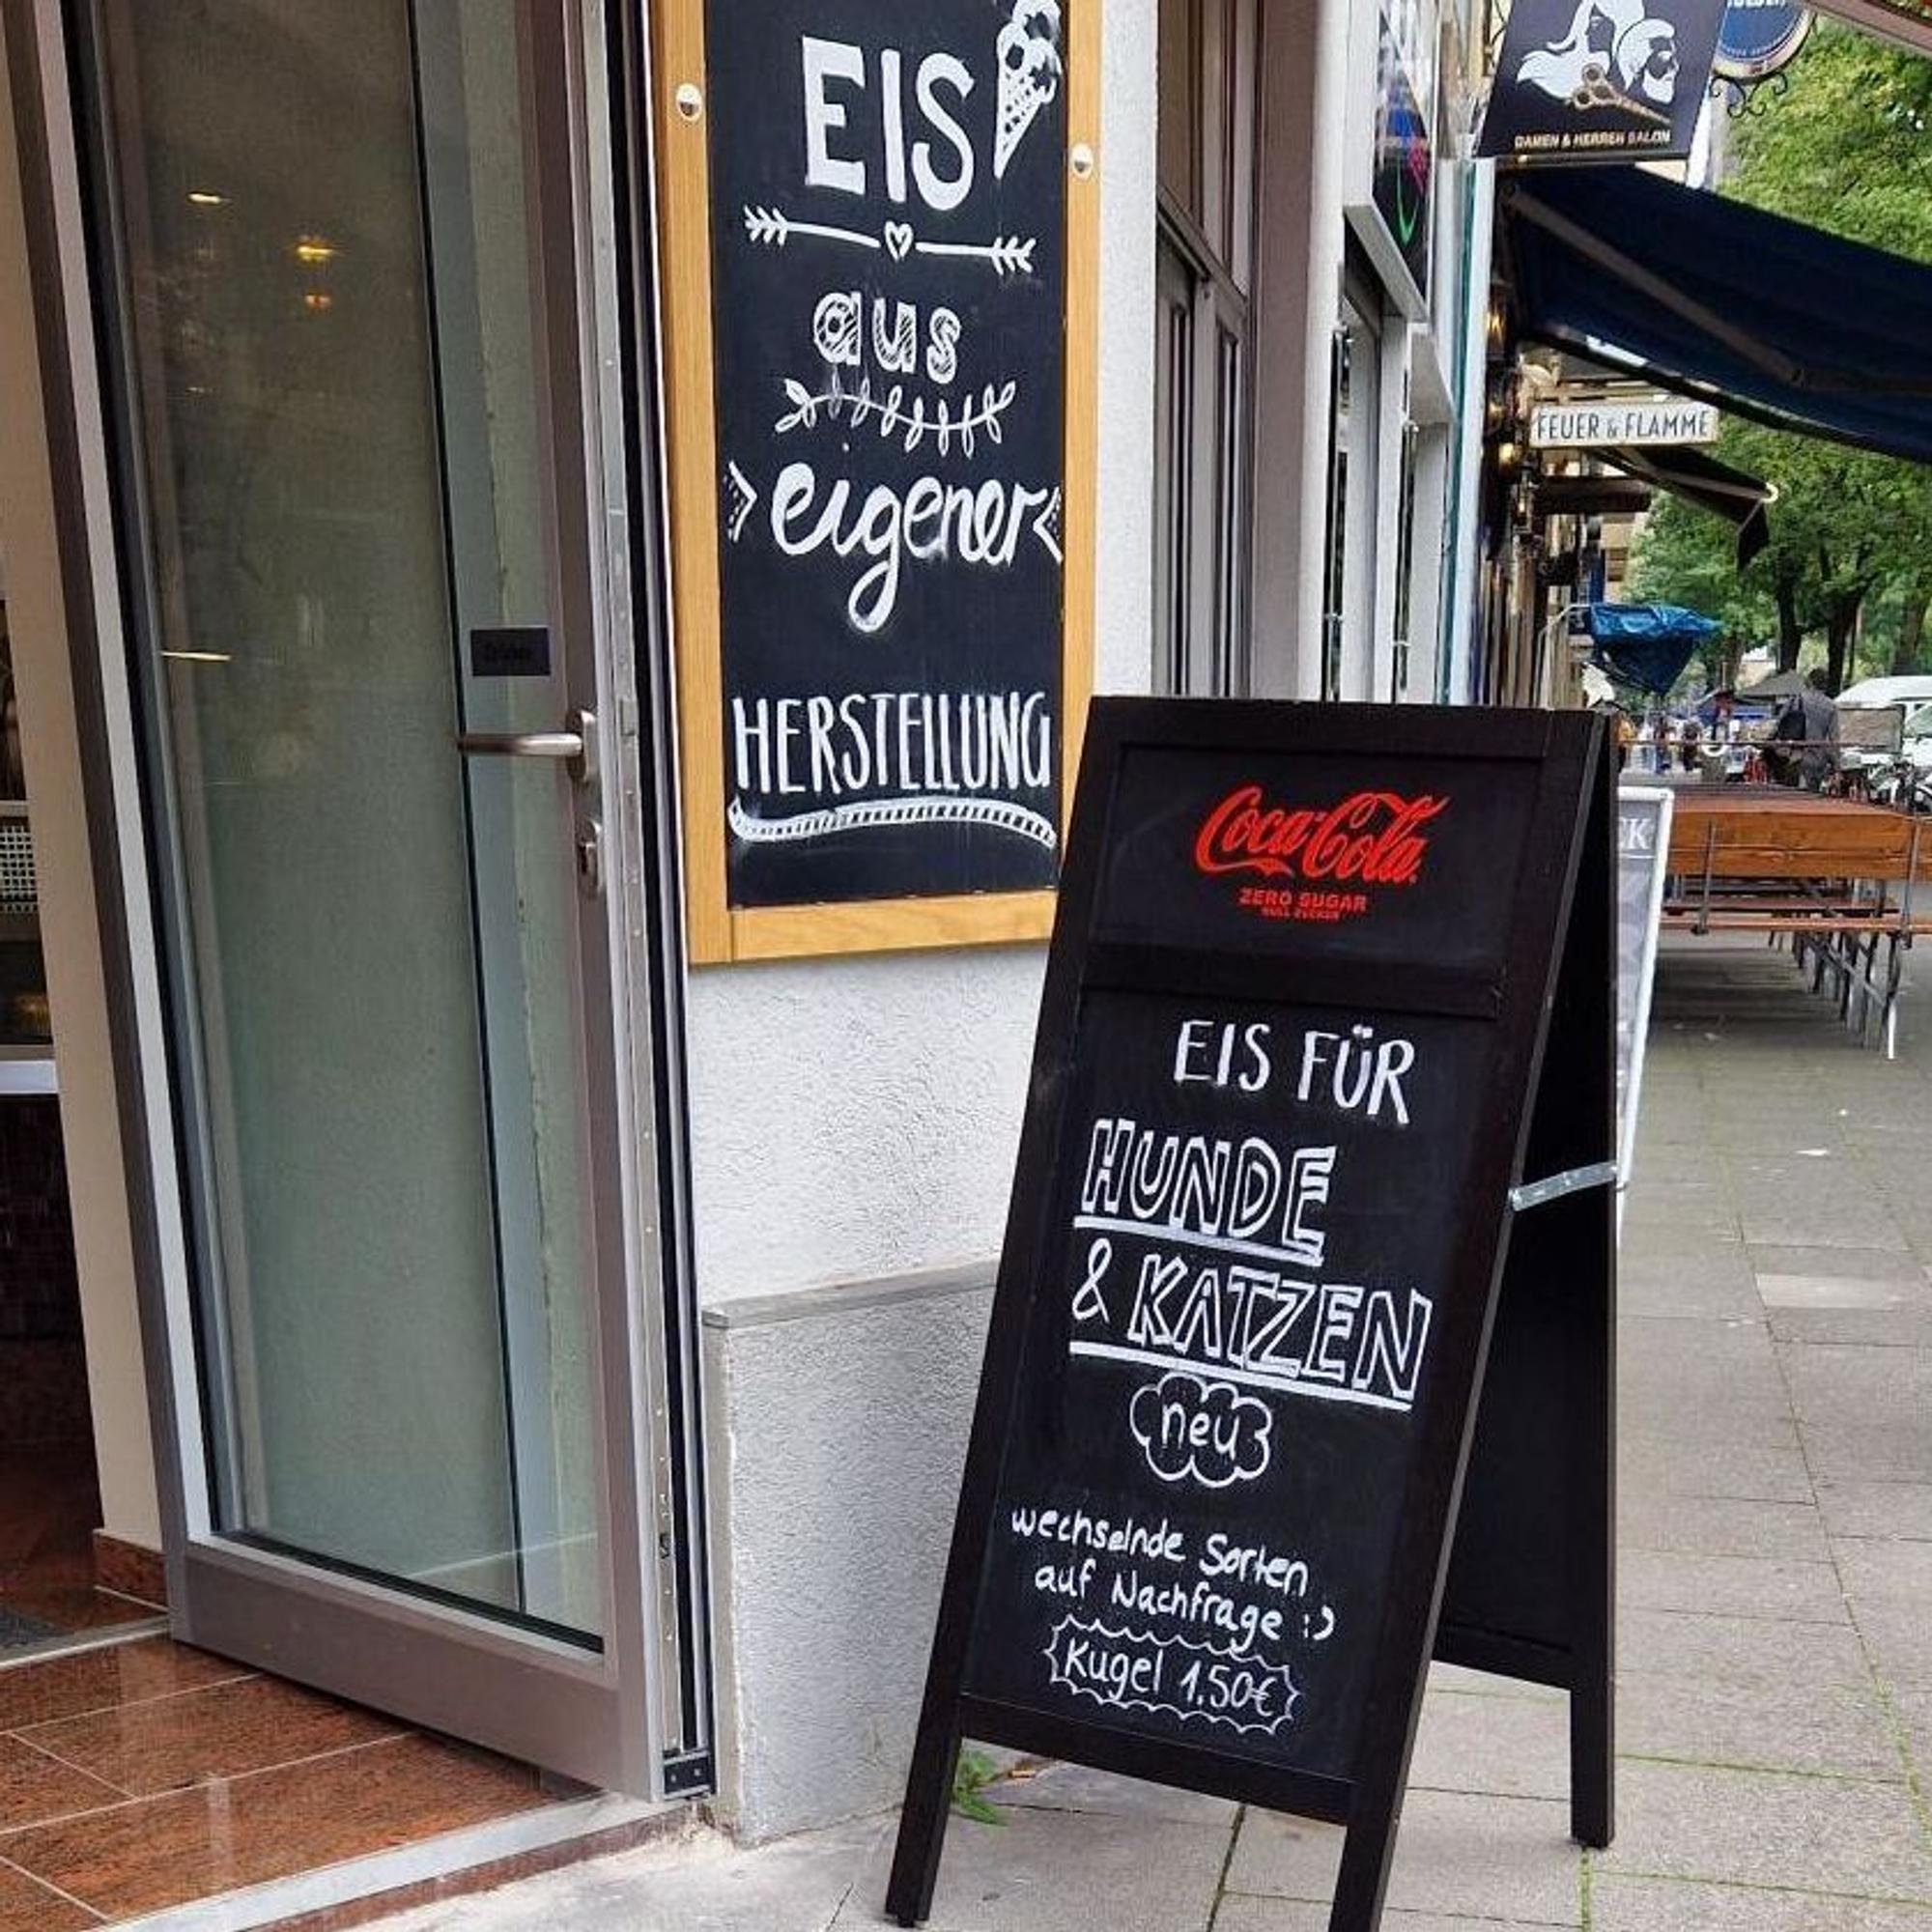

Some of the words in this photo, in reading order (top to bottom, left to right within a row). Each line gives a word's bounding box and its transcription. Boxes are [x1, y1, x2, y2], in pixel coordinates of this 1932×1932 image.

[802, 35, 975, 212] EIS
[813, 290, 961, 384] aus
[1538, 413, 1600, 440] FEUER
[1606, 419, 1618, 438] &
[1625, 410, 1709, 437] FLAMME
[772, 440, 1048, 633] eigener
[731, 691, 1051, 795] HERSTELLUNG
[1239, 888, 1293, 906] ZERO
[1298, 891, 1367, 912] SUGAR
[1174, 1019, 1271, 1093] EIS
[1297, 1024, 1415, 1125] FÜR
[1080, 1117, 1336, 1254] HUNDE
[1071, 1237, 1113, 1323] &
[1126, 1253, 1434, 1399] KATZEN
[1161, 1402, 1240, 1460] neu
[1010, 1507, 1188, 1563] wechselnde
[1200, 1533, 1310, 1598] Sorten
[1034, 1558, 1097, 1597] auf
[1111, 1572, 1284, 1649] Nachfrage
[1064, 1635, 1164, 1701] Kugel
